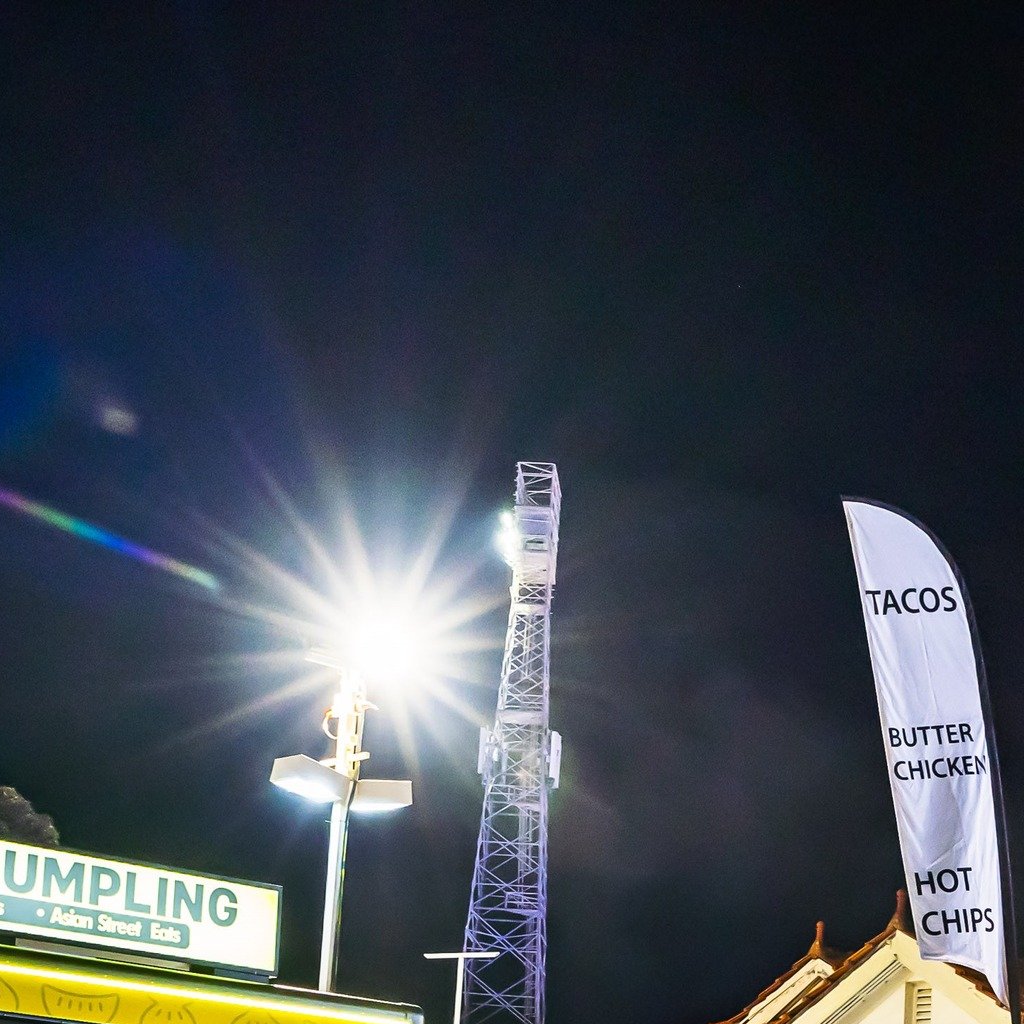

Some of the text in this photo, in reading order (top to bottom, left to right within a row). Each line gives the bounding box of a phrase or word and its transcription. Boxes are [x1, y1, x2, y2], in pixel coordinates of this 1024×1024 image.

[866, 586, 958, 615] TACOS
[889, 723, 974, 748] BUTTER
[893, 754, 988, 782] CHICKEN
[914, 867, 972, 895] HOT
[49, 907, 93, 930] Asian
[97, 914, 142, 938] Street
[150, 922, 182, 944] Eats
[921, 907, 995, 936] CHIPS
